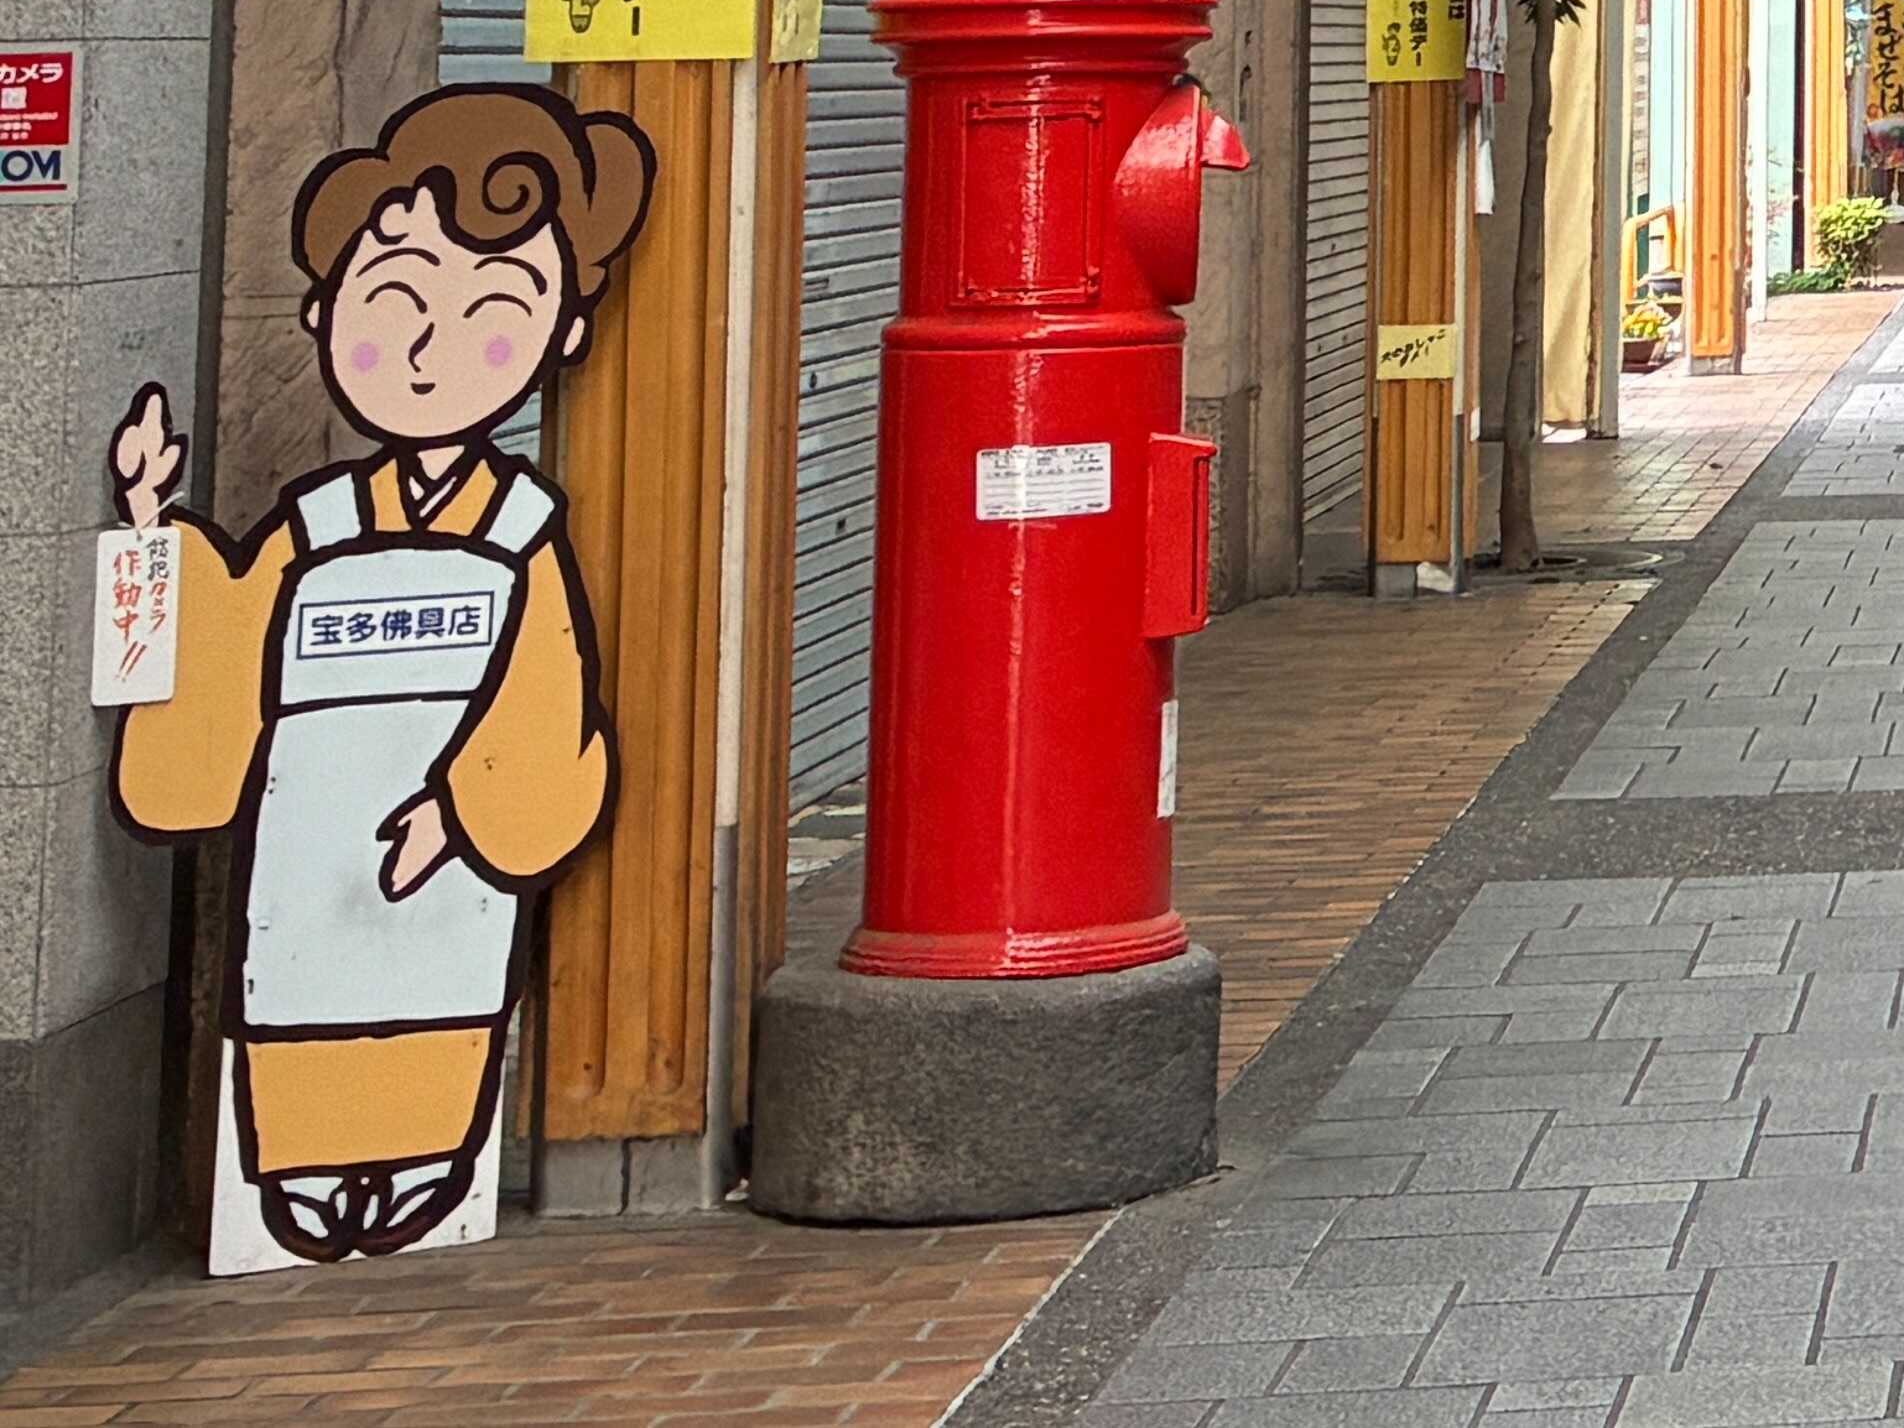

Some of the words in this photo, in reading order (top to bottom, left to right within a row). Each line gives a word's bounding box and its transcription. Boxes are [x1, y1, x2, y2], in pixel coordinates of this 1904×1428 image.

[309, 603, 483, 647] 宝多佛具店
